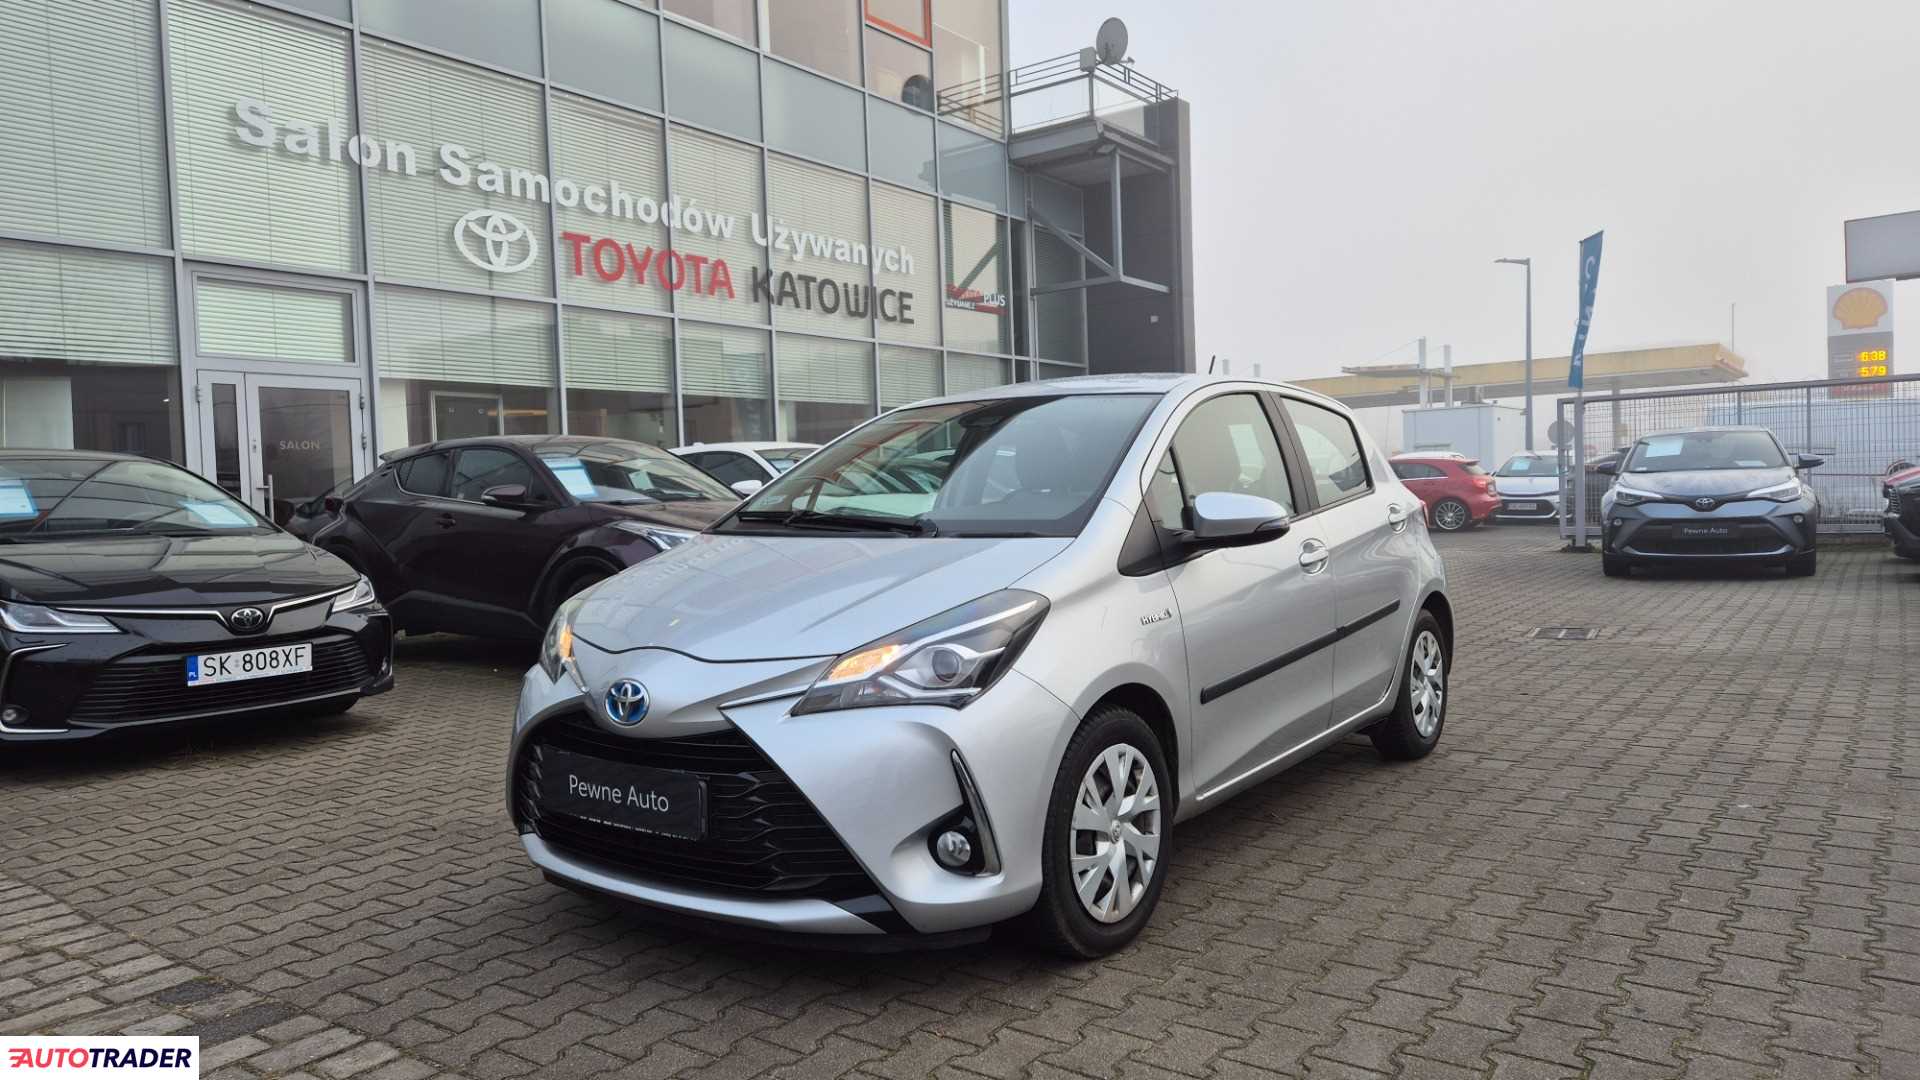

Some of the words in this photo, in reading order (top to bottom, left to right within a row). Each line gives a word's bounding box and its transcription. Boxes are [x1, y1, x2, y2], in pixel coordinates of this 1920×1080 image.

[234, 97, 417, 176] Salon
[439, 143, 735, 238] Samochodów
[751, 212, 915, 275] Używanych
[561, 231, 735, 299] TOYOTA
[751, 266, 915, 325] KATOWICE
[984, 291, 1006, 306] PLUS
[280, 440, 319, 449] SALON
[203, 655, 232, 677] SK
[242, 646, 306, 672] 808XF
[569, 774, 622, 803] Pewne
[627, 786, 669, 812] Auto
